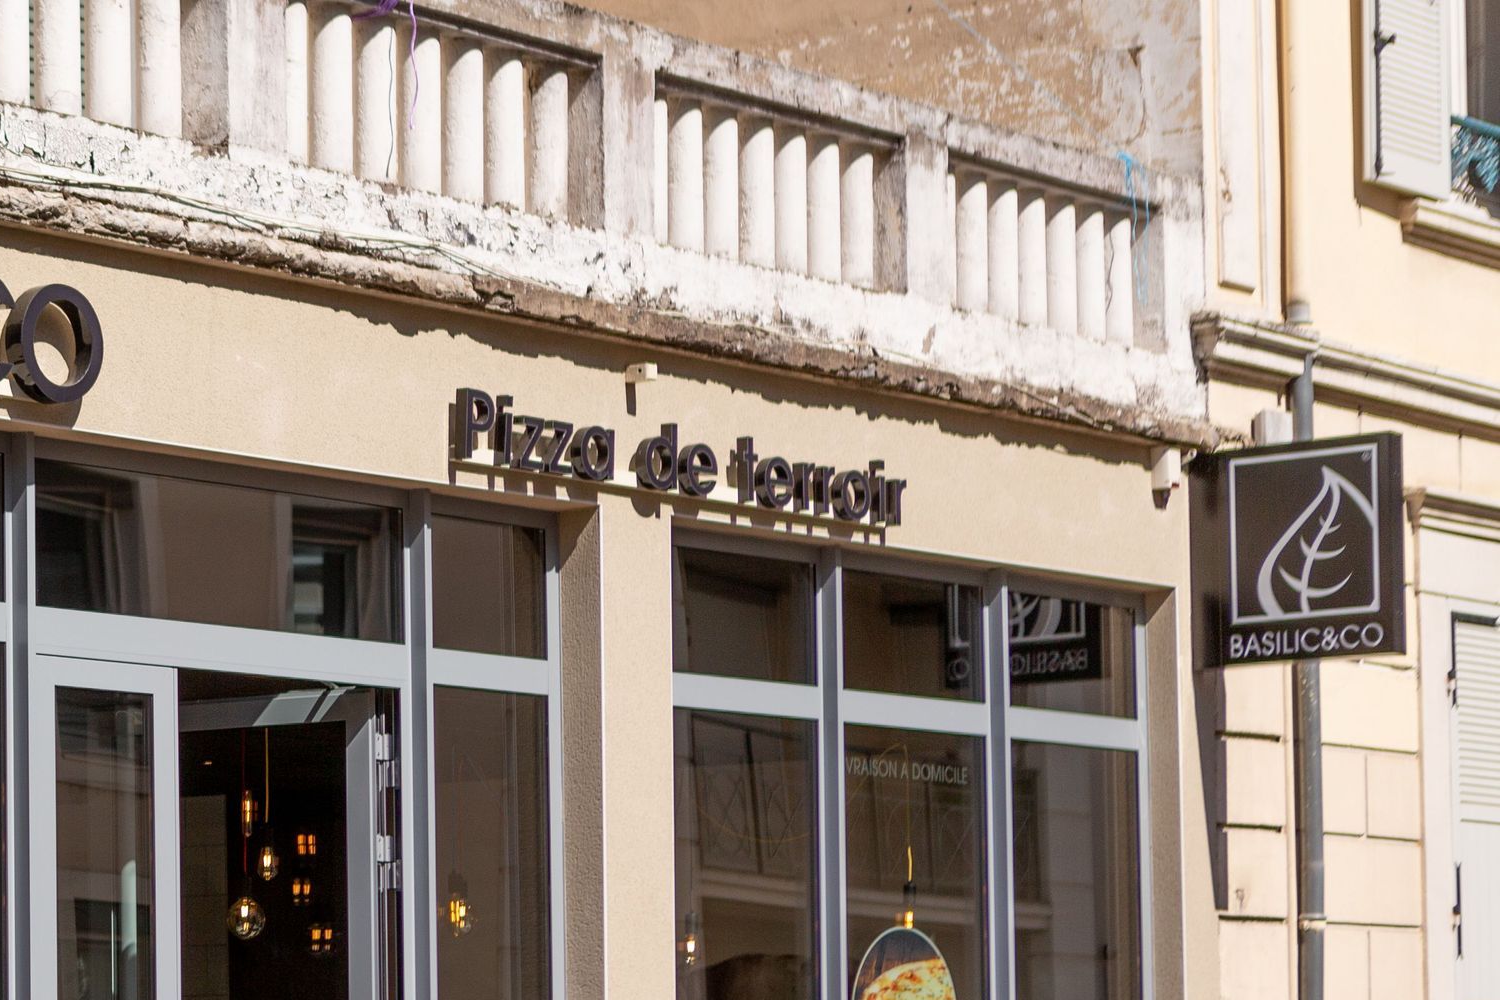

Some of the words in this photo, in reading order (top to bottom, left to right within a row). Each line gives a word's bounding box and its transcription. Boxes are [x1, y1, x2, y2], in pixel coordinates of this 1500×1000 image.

[455, 387, 615, 481] Pizza
[636, 422, 719, 496] de
[735, 435, 907, 527] terroir
[1229, 621, 1385, 660] BASILIC&CO
[912, 762, 968, 786] DOMICILE
